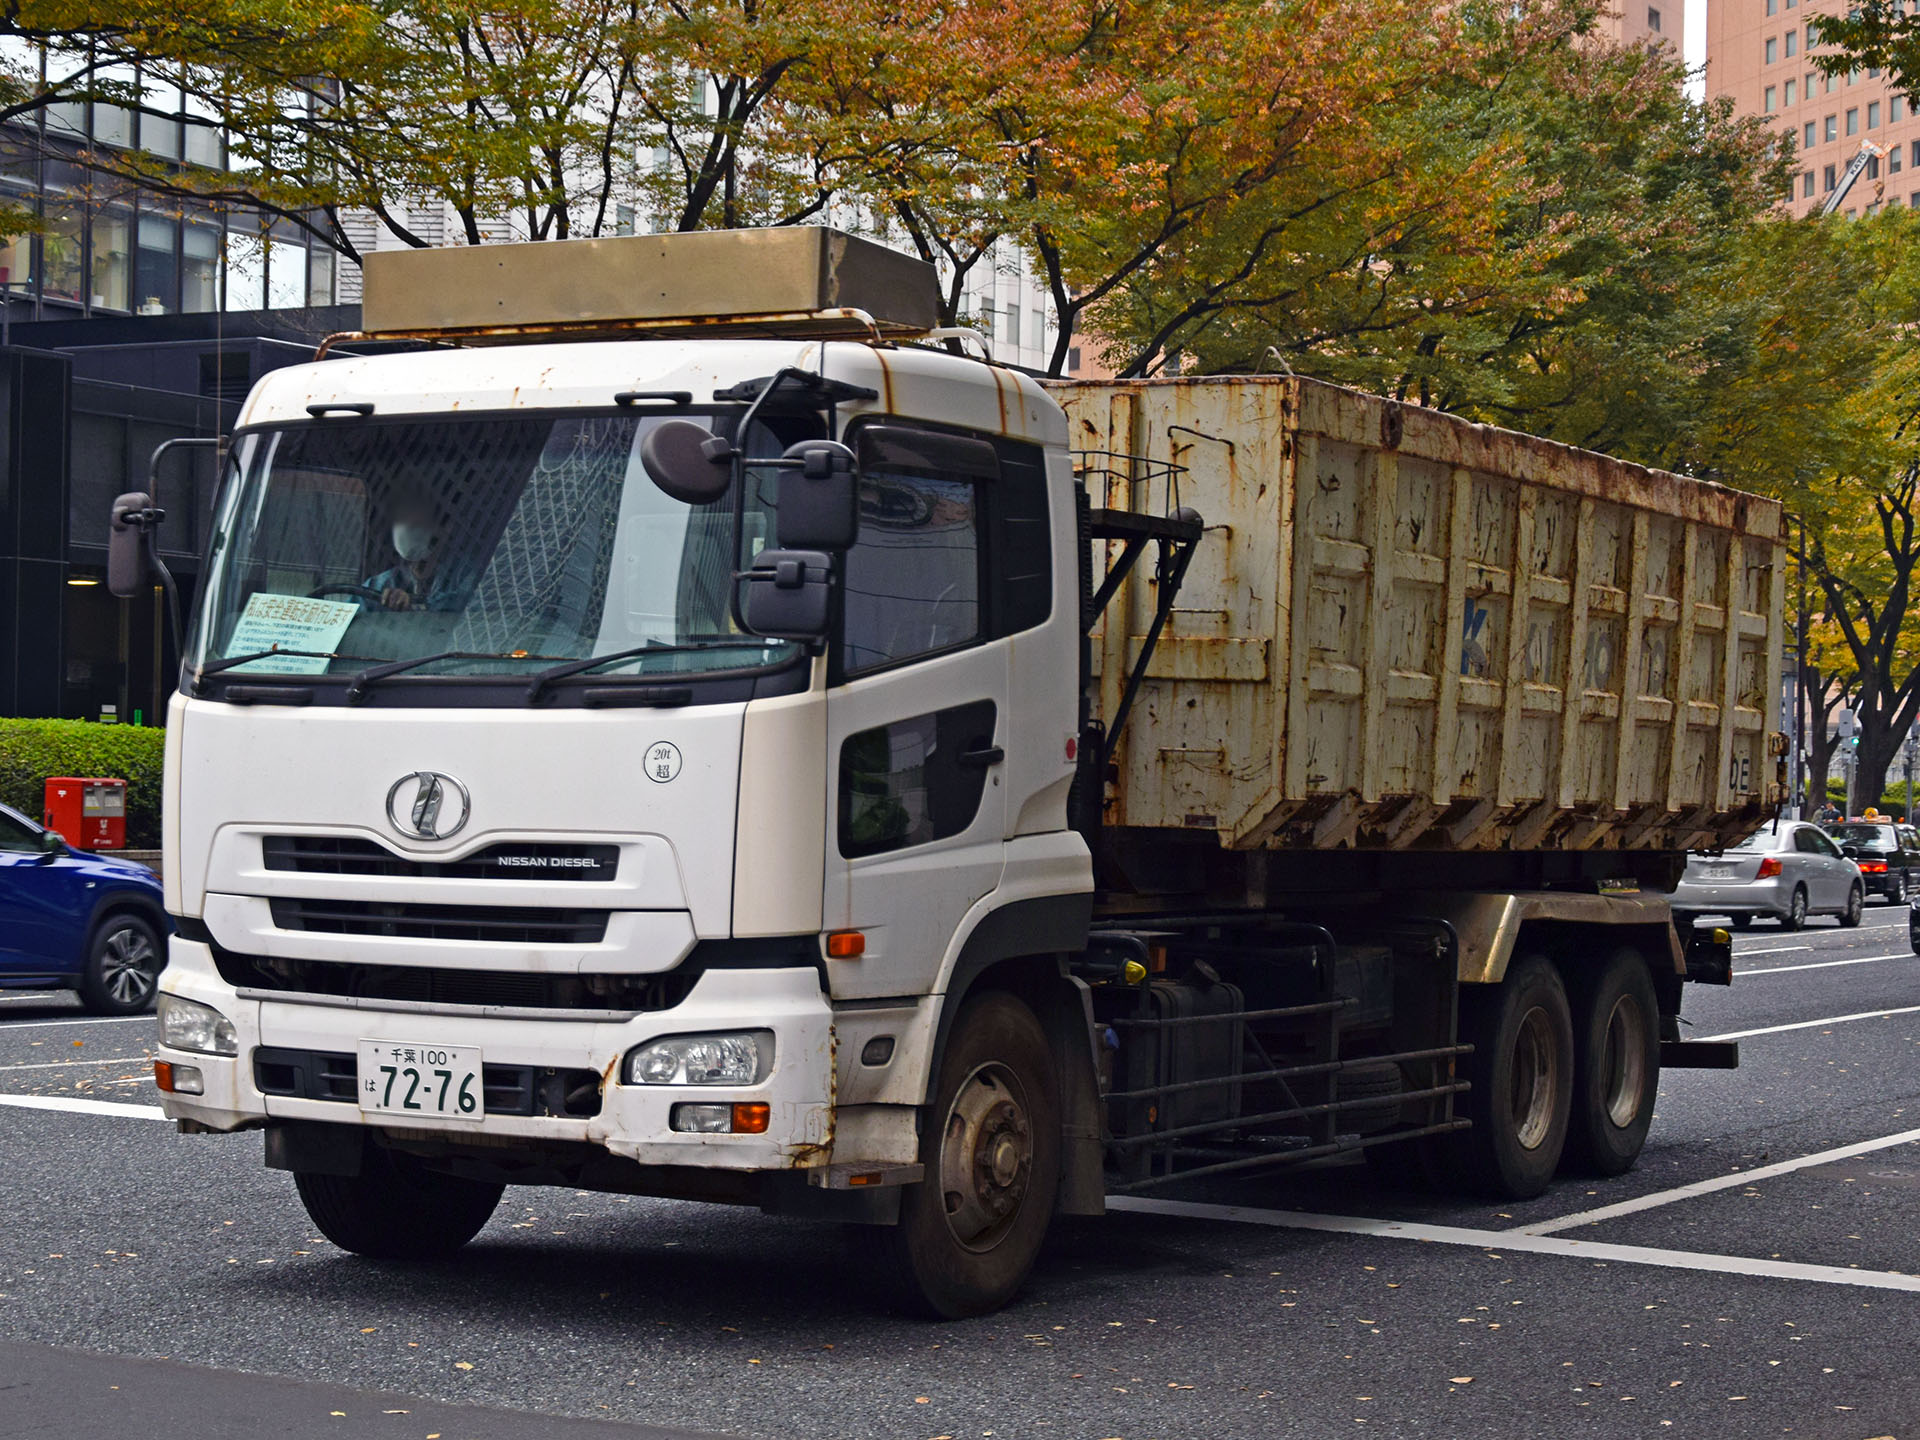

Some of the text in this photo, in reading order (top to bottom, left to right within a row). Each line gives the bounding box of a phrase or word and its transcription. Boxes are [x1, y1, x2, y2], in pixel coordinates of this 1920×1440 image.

[1850, 153, 1867, 175] KATO
[656, 764, 671, 779] 超
[498, 856, 600, 868] NISSAN DIESEL
[365, 1065, 476, 1113] は 72-76
